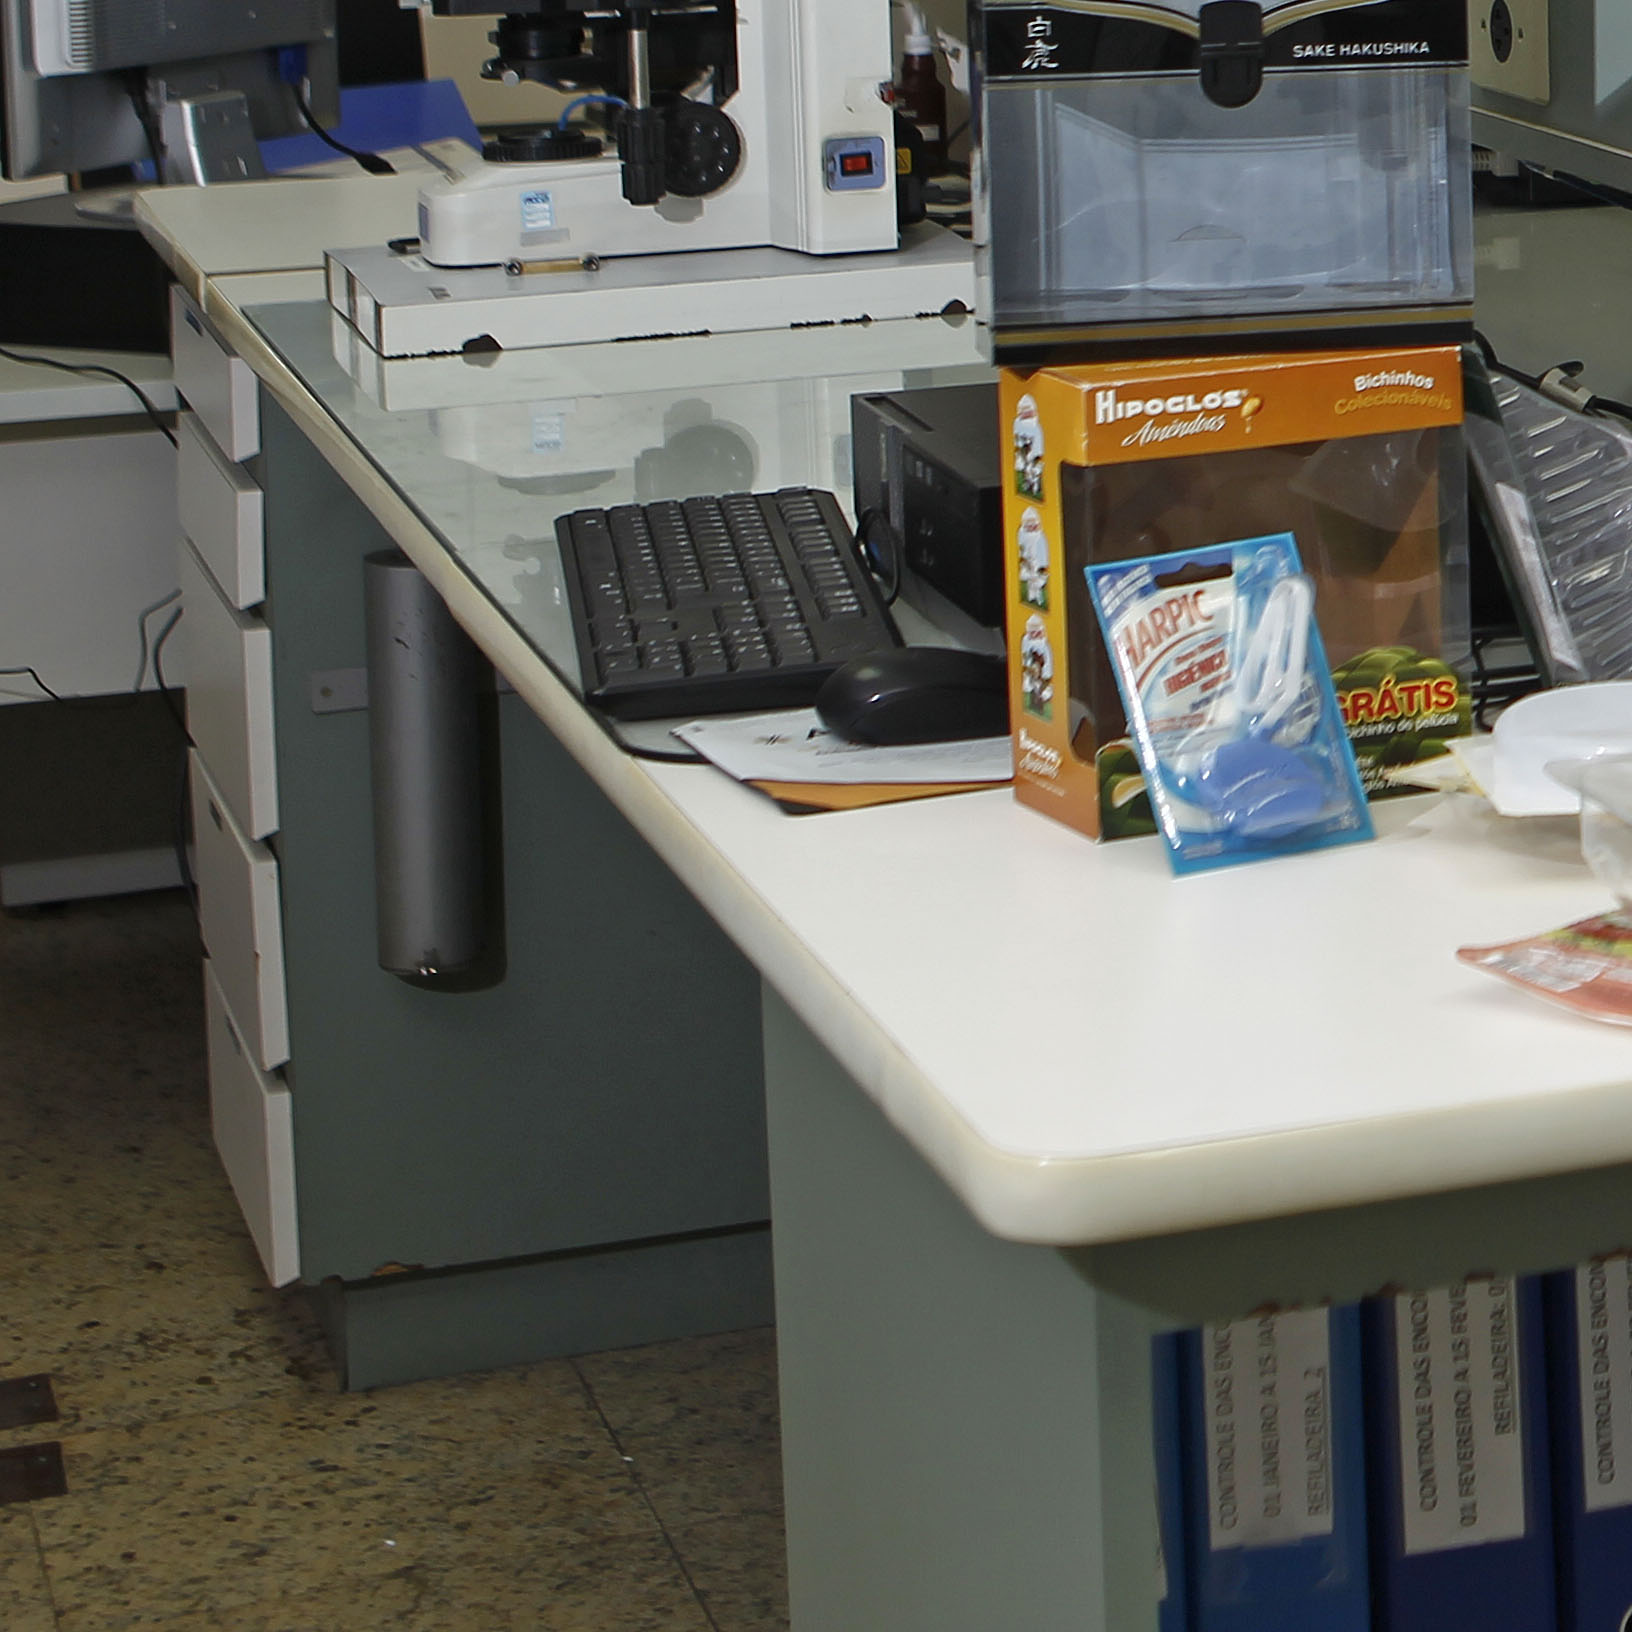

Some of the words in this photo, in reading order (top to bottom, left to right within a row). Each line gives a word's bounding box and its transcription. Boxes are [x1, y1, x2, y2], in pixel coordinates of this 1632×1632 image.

[1292, 44, 1335, 58] SAKE
[1340, 41, 1430, 56] HAKUSHIKA
[1353, 370, 1435, 392] Bichinhos
[1334, 389, 1453, 415] Colecionáveis
[1259, 1355, 1276, 1376] 15
[1452, 1340, 1469, 1362] 15
[1592, 1334, 1610, 1375] DAS
[1304, 1368, 1322, 1379] 2
[1414, 1357, 1432, 1399] DAS
[1215, 1376, 1233, 1416] DAS
[1261, 1404, 1280, 1487] JANEIRO
[1454, 1389, 1476, 1497] FEVEREIRO
[1594, 1379, 1614, 1485] CONTROLE
[1306, 1390, 1325, 1516] REFILADEIRA
[1416, 1403, 1437, 1512] CONTROLE
[1217, 1421, 1239, 1530] CONTROLE
[1264, 1492, 1281, 1517] 01
[1460, 1499, 1477, 1527] 01
